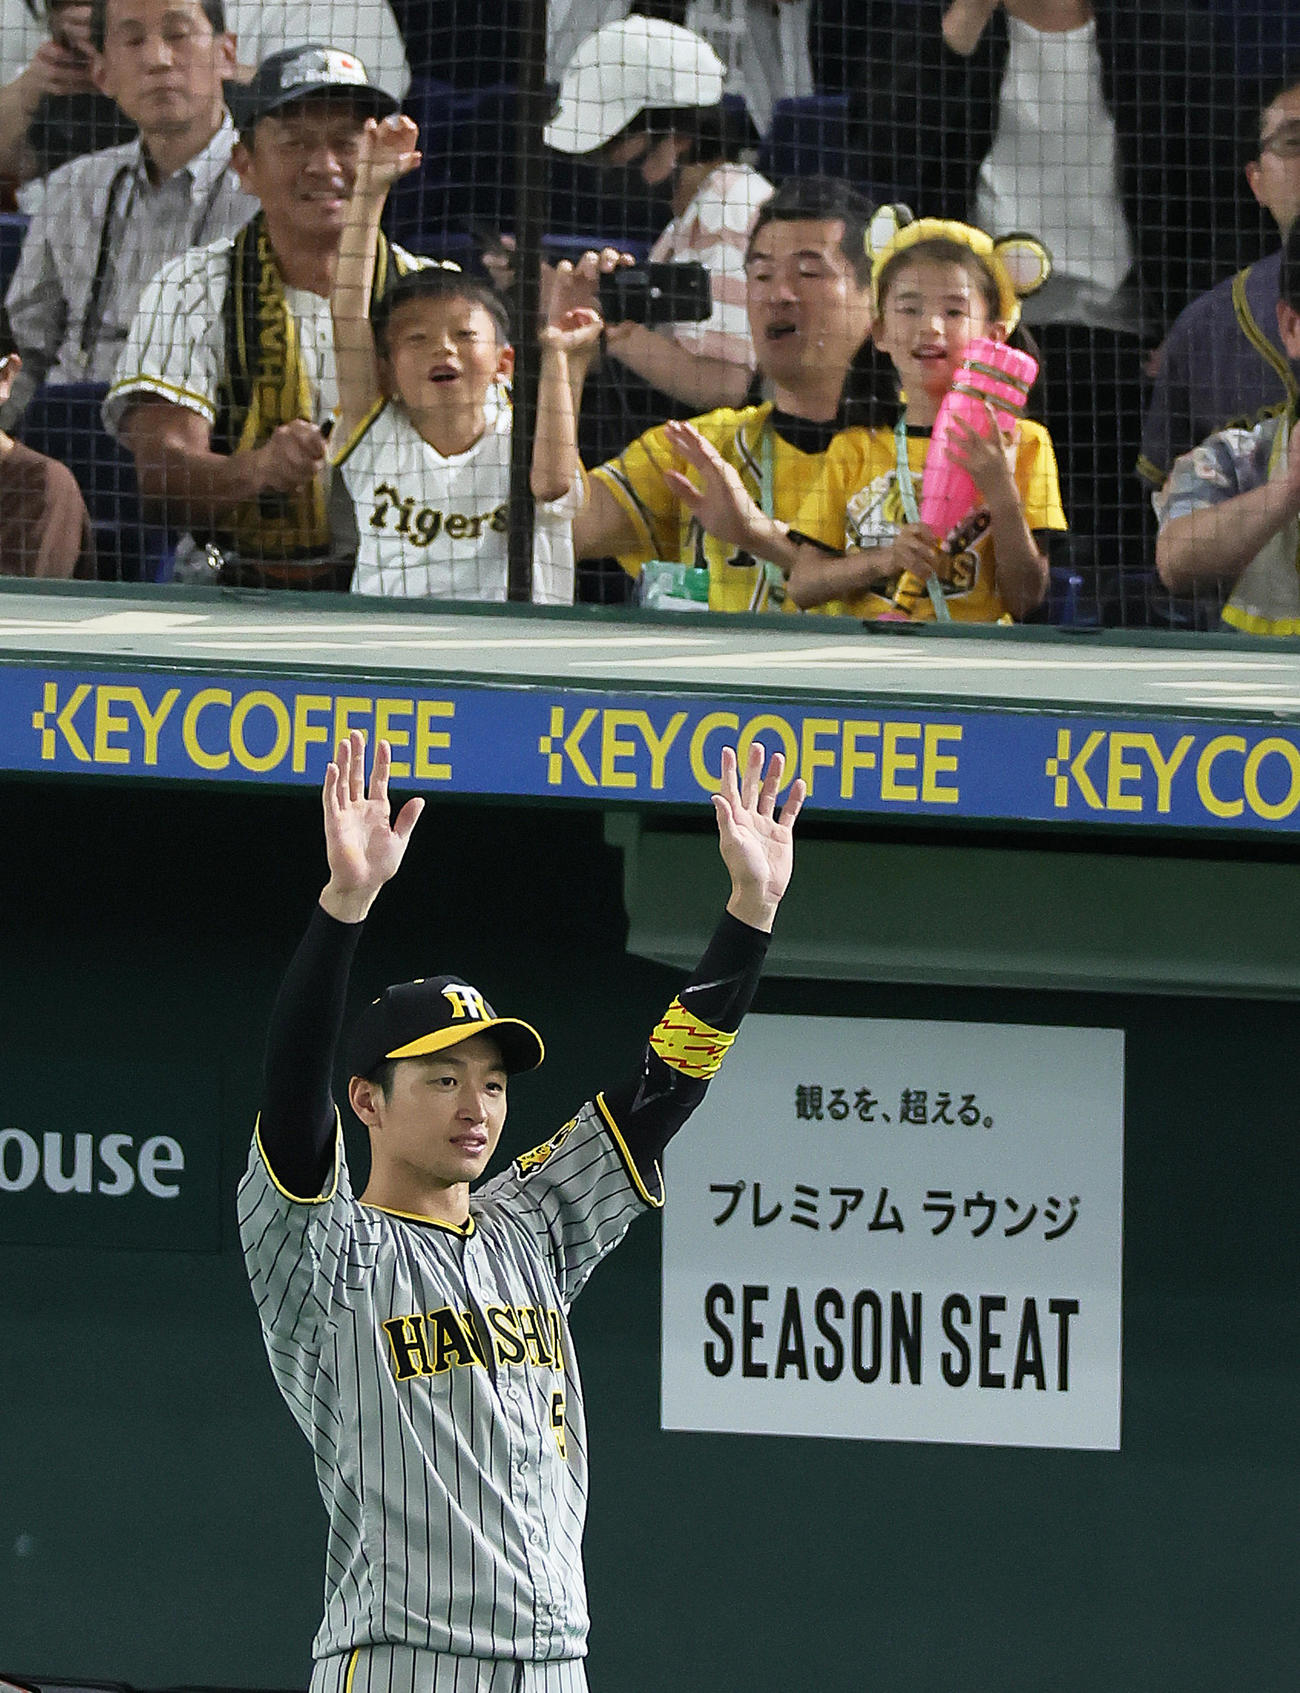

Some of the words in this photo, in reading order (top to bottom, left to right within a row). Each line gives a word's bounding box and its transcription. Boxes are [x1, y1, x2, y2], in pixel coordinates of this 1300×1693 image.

[370, 482, 509, 547] Tigers
[795, 1084, 994, 1129] 観るを、超える。
[0, 1128, 185, 1198] ouse
[709, 1180, 905, 1234] プレミアム
[922, 1190, 1081, 1241] ラウンジ
[704, 1283, 923, 1386] SEASON
[940, 1293, 1080, 1391] SEAT
